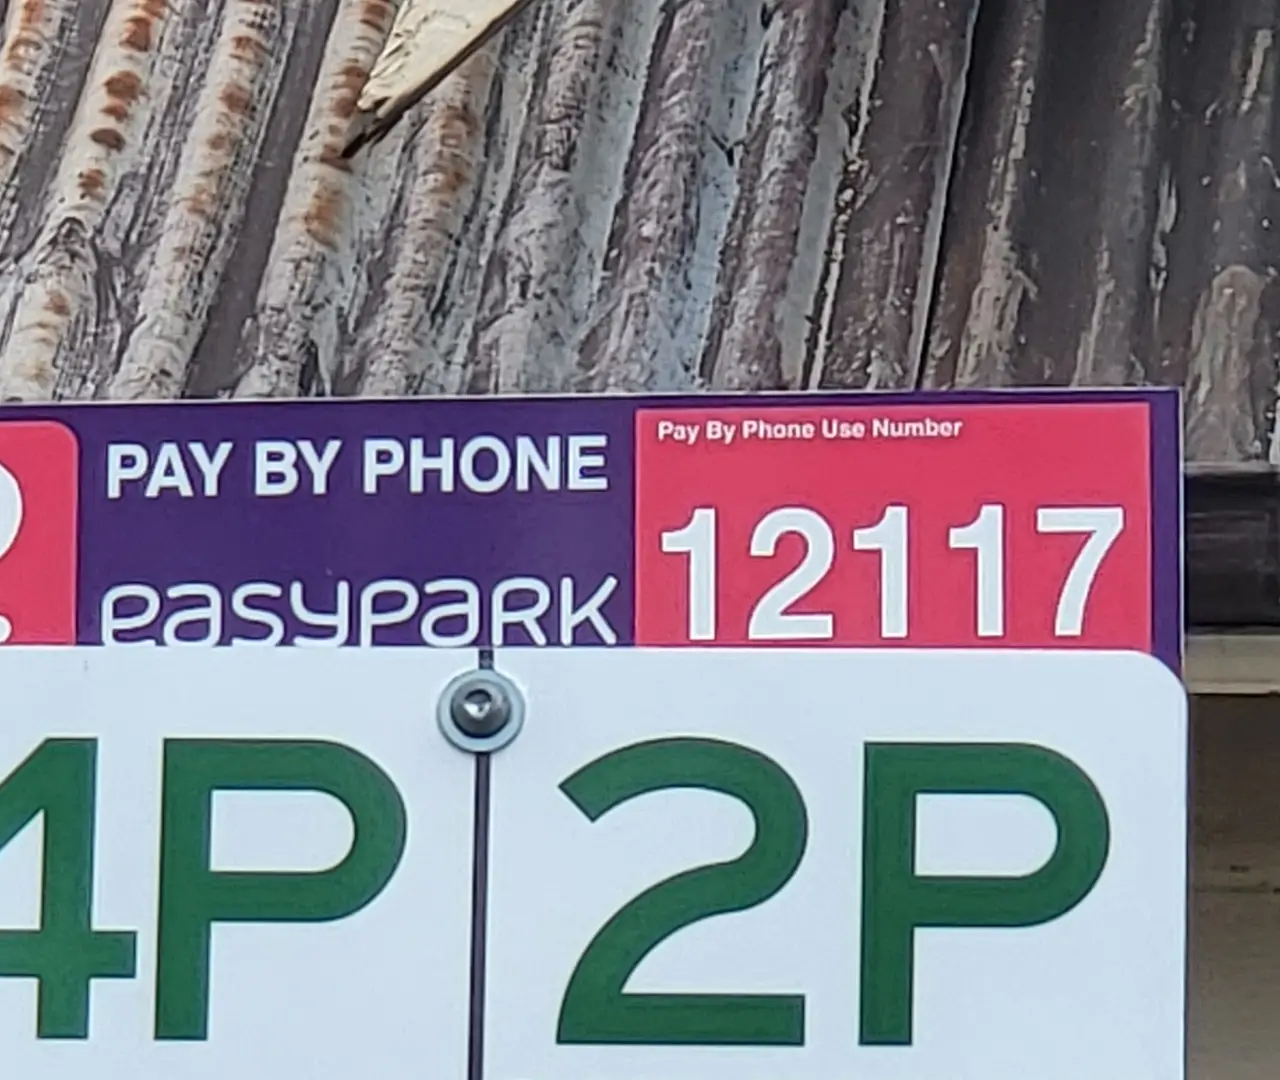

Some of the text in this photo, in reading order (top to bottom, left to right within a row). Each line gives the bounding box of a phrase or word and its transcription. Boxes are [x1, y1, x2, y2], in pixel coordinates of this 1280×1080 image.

[106, 434, 609, 498] PAY BY PHONE
[657, 417, 964, 445] Pay By Phone Use Number
[660, 503, 1126, 641] 12117
[553, 735, 1112, 1049] 2P
